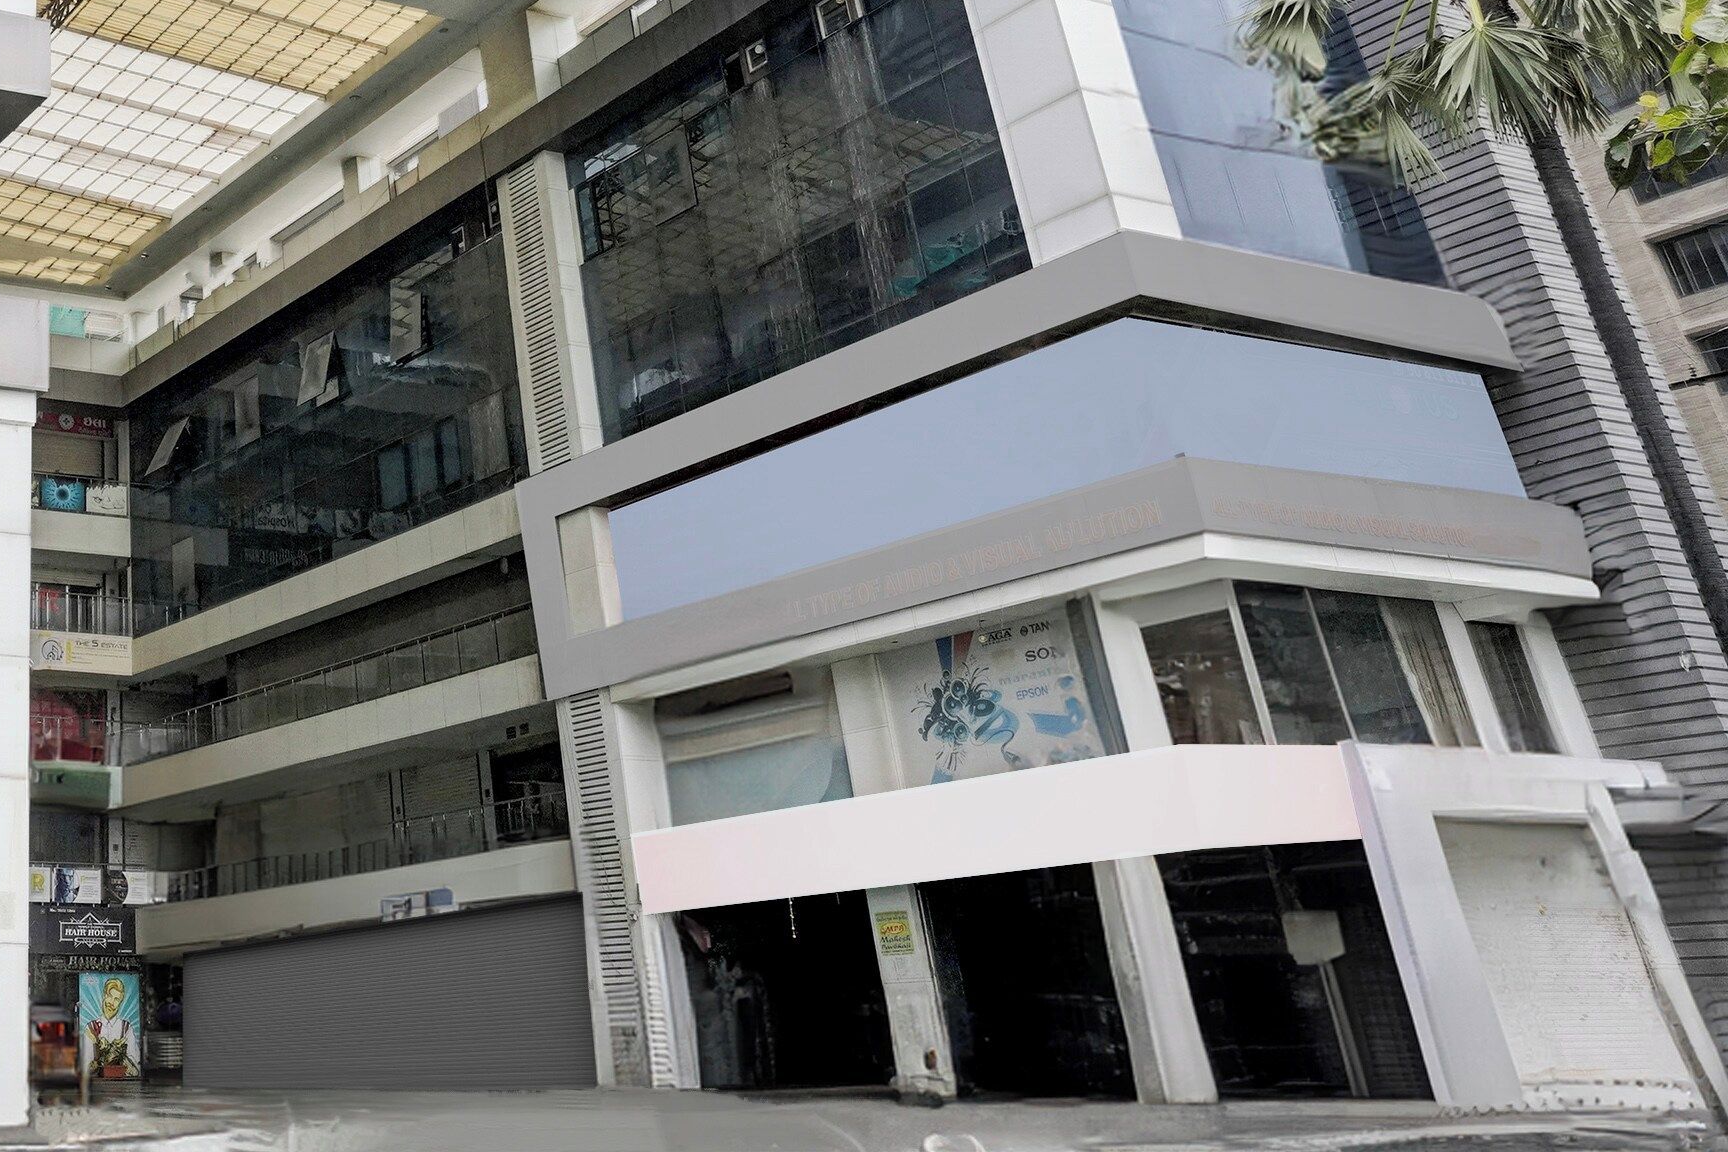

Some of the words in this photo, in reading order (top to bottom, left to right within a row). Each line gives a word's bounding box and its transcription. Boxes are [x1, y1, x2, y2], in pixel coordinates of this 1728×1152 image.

[1016, 685, 1049, 700] EPSON
[65, 928, 87, 936] HAIR
[88, 929, 117, 937] HOUSE
